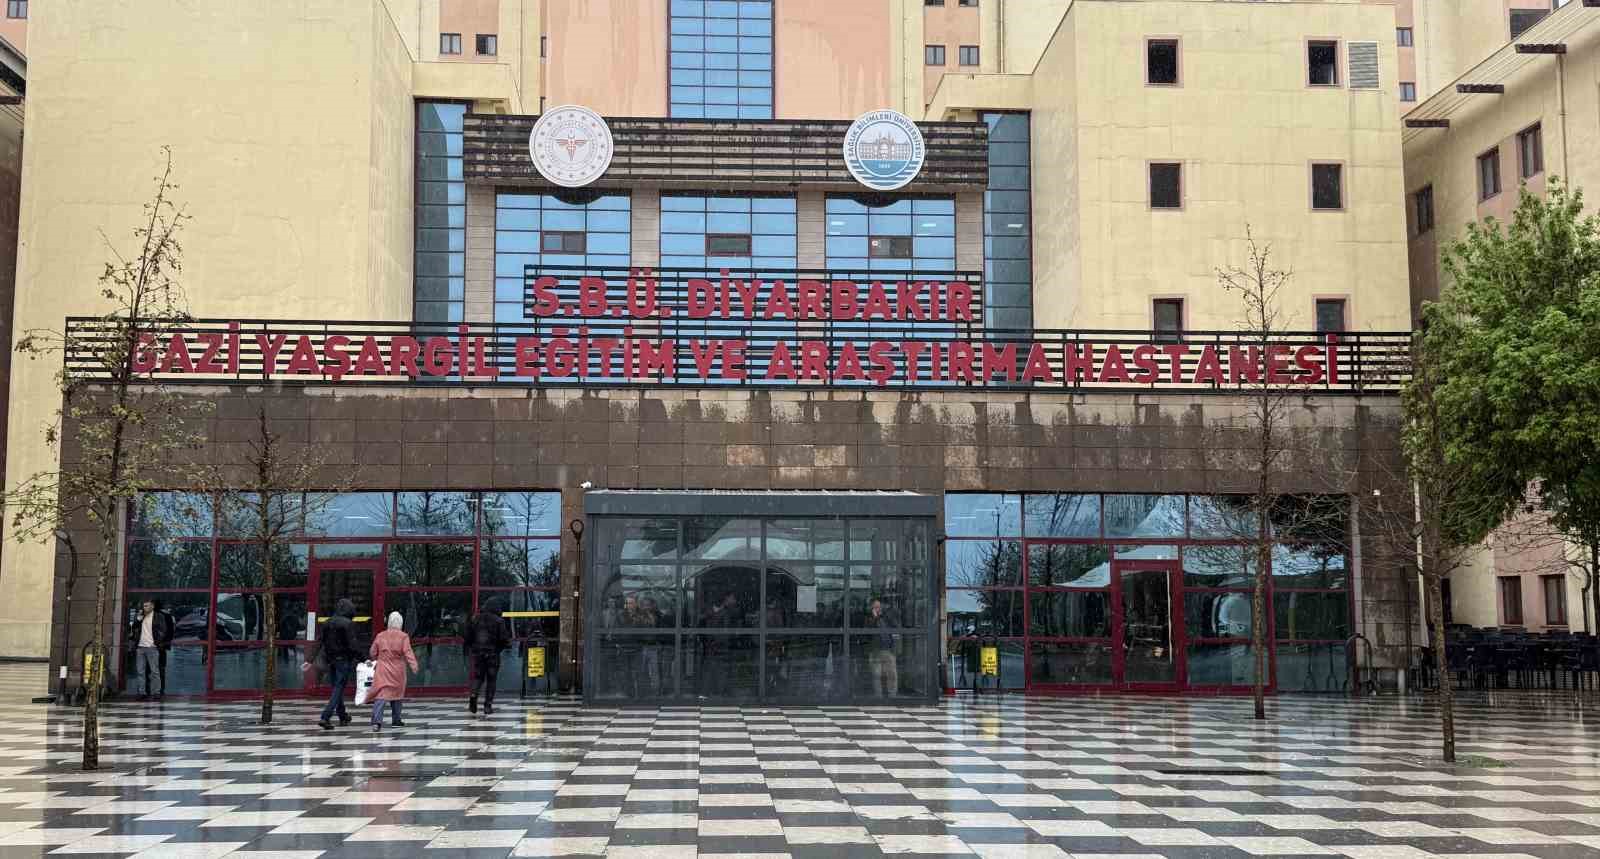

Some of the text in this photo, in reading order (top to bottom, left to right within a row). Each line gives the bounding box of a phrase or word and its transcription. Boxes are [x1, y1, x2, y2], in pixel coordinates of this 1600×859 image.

[533, 266, 974, 322] S.B.Ü. DİYARBAKIR
[130, 321, 1339, 388] GAZİ YAŞARGİL EĞİTİM VE ARAŞTIRMA HASTANESİ
